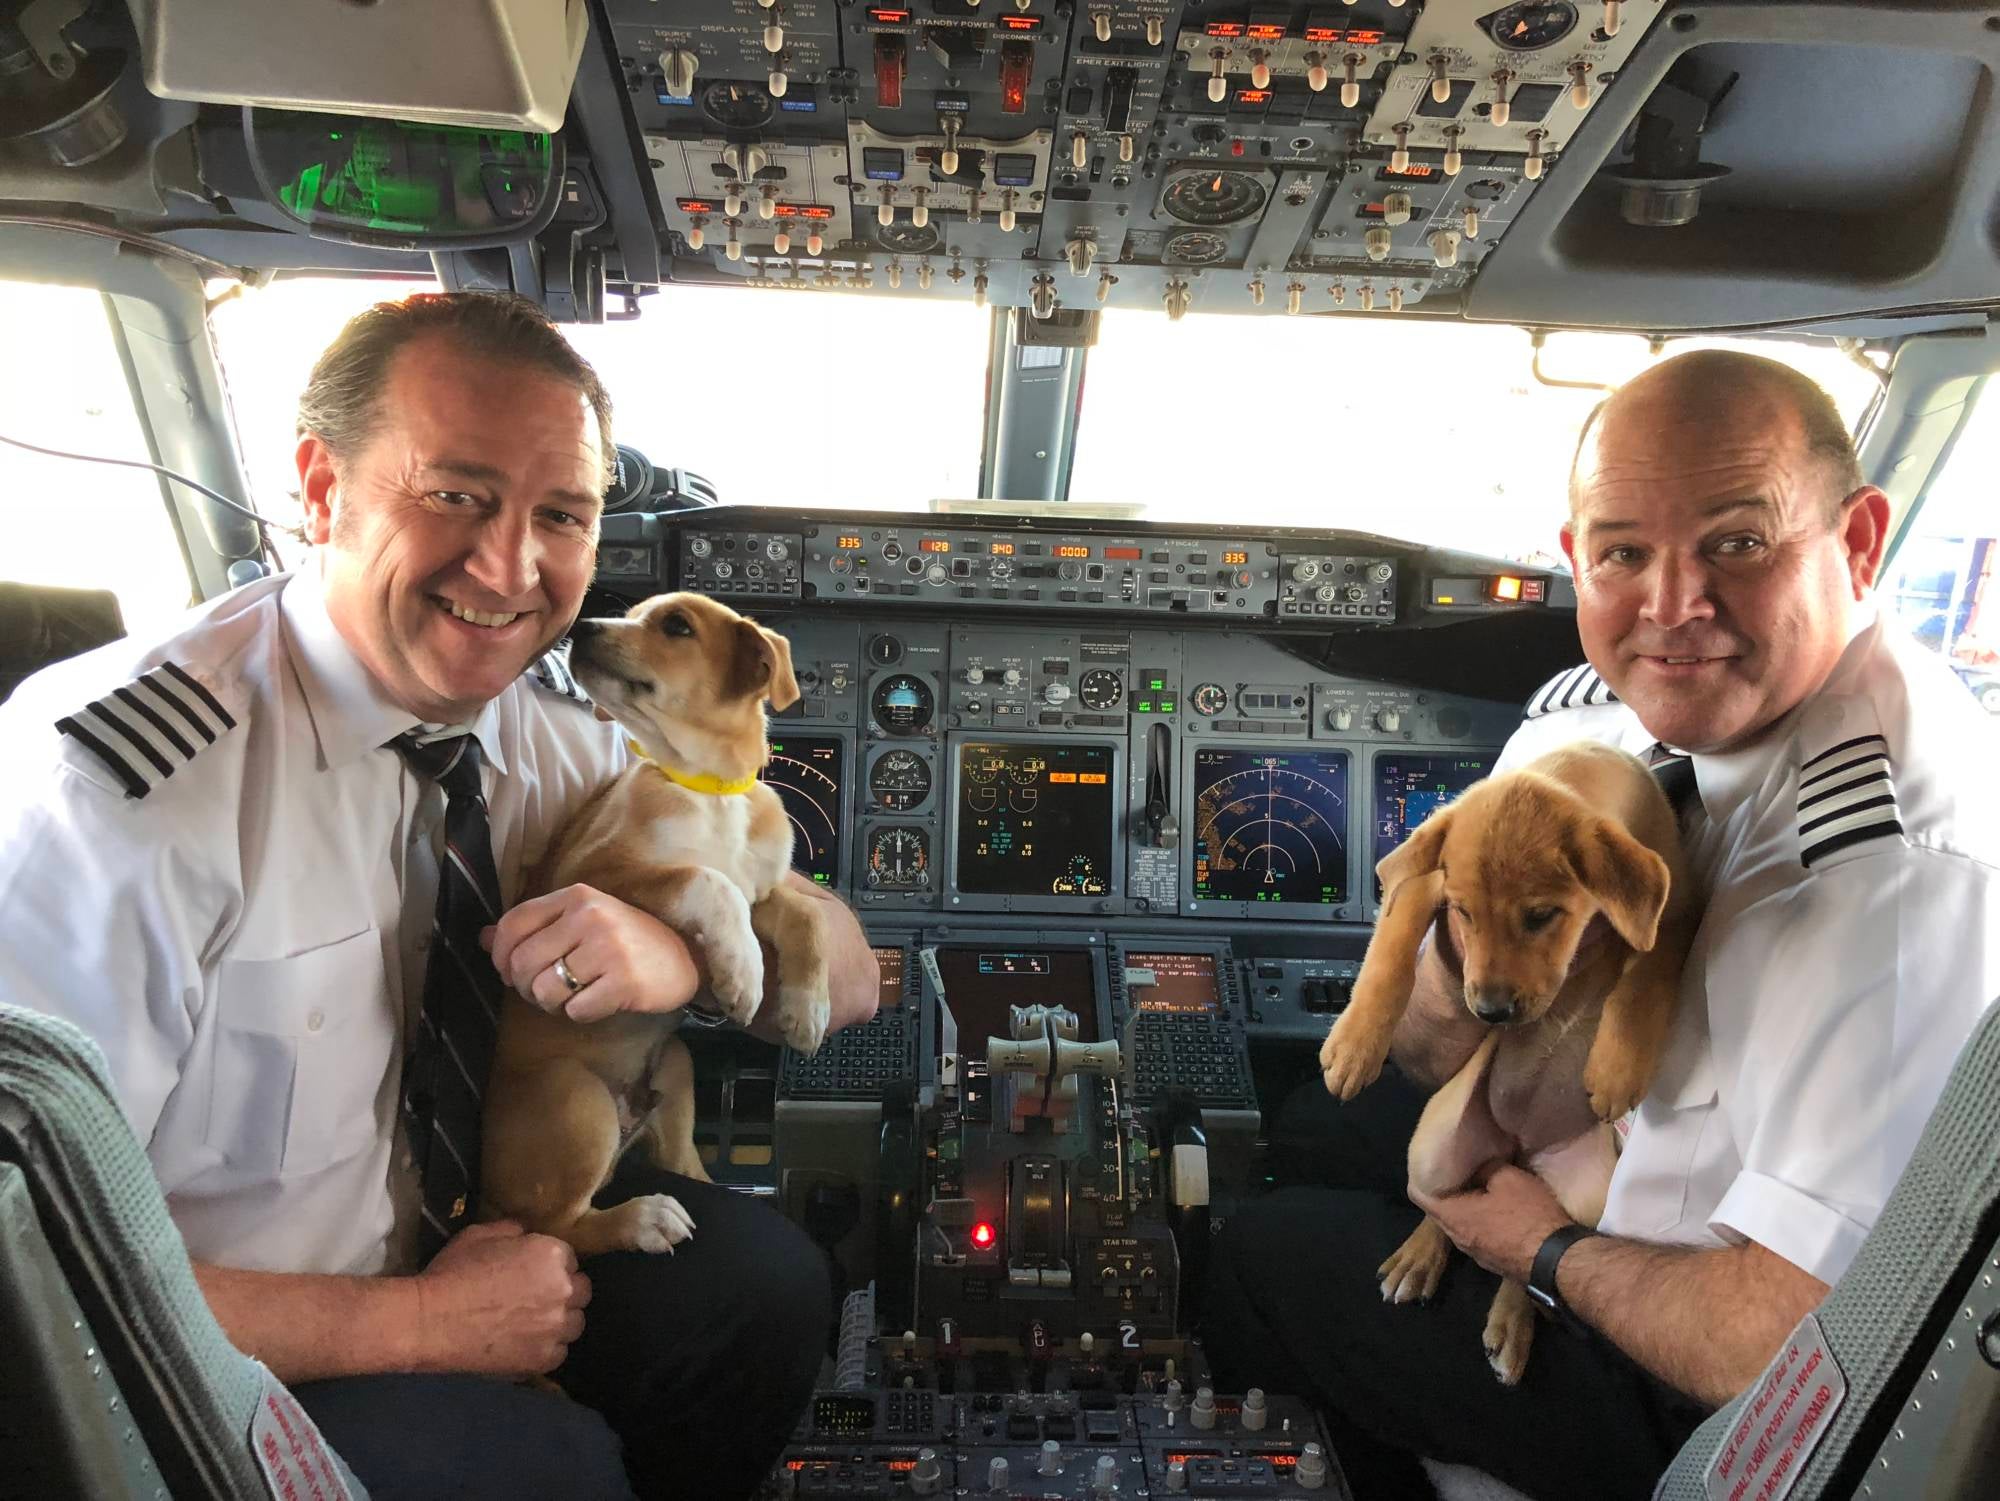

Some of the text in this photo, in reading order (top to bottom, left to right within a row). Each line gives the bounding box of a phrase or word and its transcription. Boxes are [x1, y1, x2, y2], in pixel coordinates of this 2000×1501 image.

[1088, 3, 1119, 11] SUPPLY
[1137, 6, 1175, 14] EXHAUST
[878, 14, 900, 22] DRIVE
[915, 18, 996, 29] STANDBY POWER
[655, 30, 692, 38] SOURCE
[701, 25, 749, 34] DISPLAYS
[867, 27, 917, 35] DISCONNECT
[992, 33, 1042, 41] DISCONNECT
[786, 42, 818, 50] PANEL
[1076, 58, 1161, 69] EMER EXIT LIGHTS
[839, 537, 860, 548] 335
[930, 542, 948, 551] 128
[992, 544, 1013, 554] 340
[1060, 547, 1088, 557] 0000
[1225, 552, 1246, 563] 335
[991, 760, 1005, 768] 0.0
[1032, 761, 1045, 770] 0.0
[924, 953, 932, 966] SPD
[1084, 1045, 1092, 1054] 2
[942, 1322, 951, 1345] 1
[1120, 1325, 1140, 1349] 2
[1735, 1414, 1753, 1445] REST
[1753, 1380, 1777, 1418] MUST
[1774, 1361, 1788, 1384] BE
[1787, 1344, 1799, 1364] IN
[1745, 1437, 1769, 1476] FLIGHT
[1765, 1386, 1800, 1441] POSITION
[1796, 1347, 1823, 1387] WHEN
[1764, 1449, 1794, 1498] MOVING
[1792, 1384, 1831, 1451] OUTBOARD
